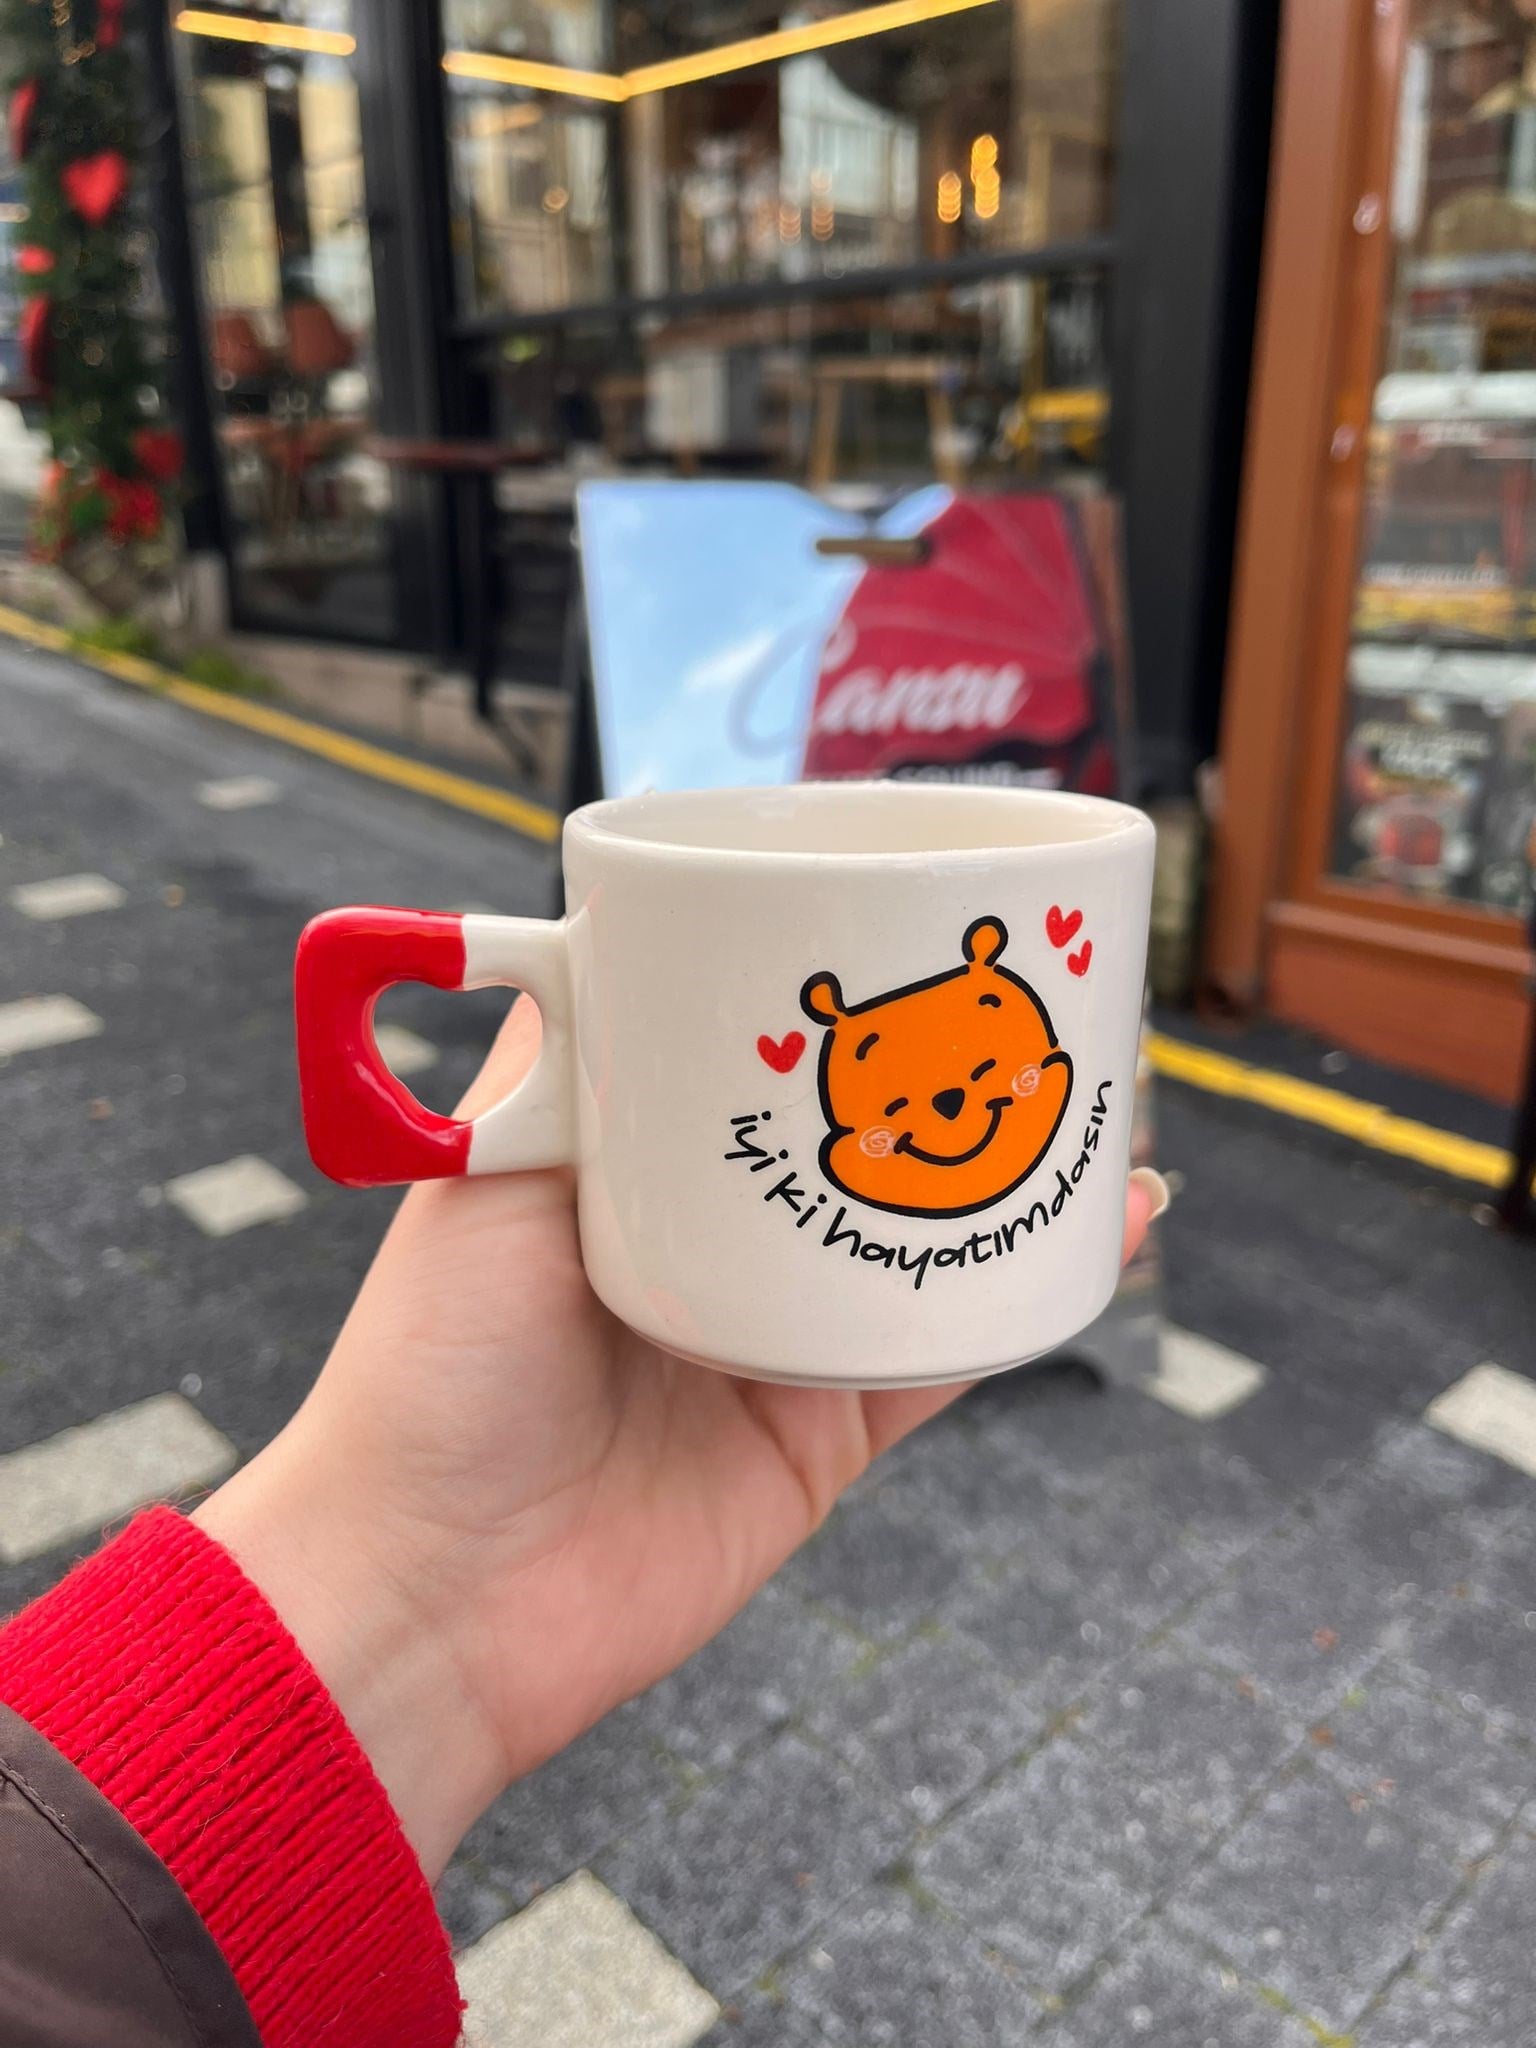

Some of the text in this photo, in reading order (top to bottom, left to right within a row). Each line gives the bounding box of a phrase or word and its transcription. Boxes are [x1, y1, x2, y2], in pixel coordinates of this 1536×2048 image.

[724, 1080, 1113, 1291] iyi ki hayatımdasın
